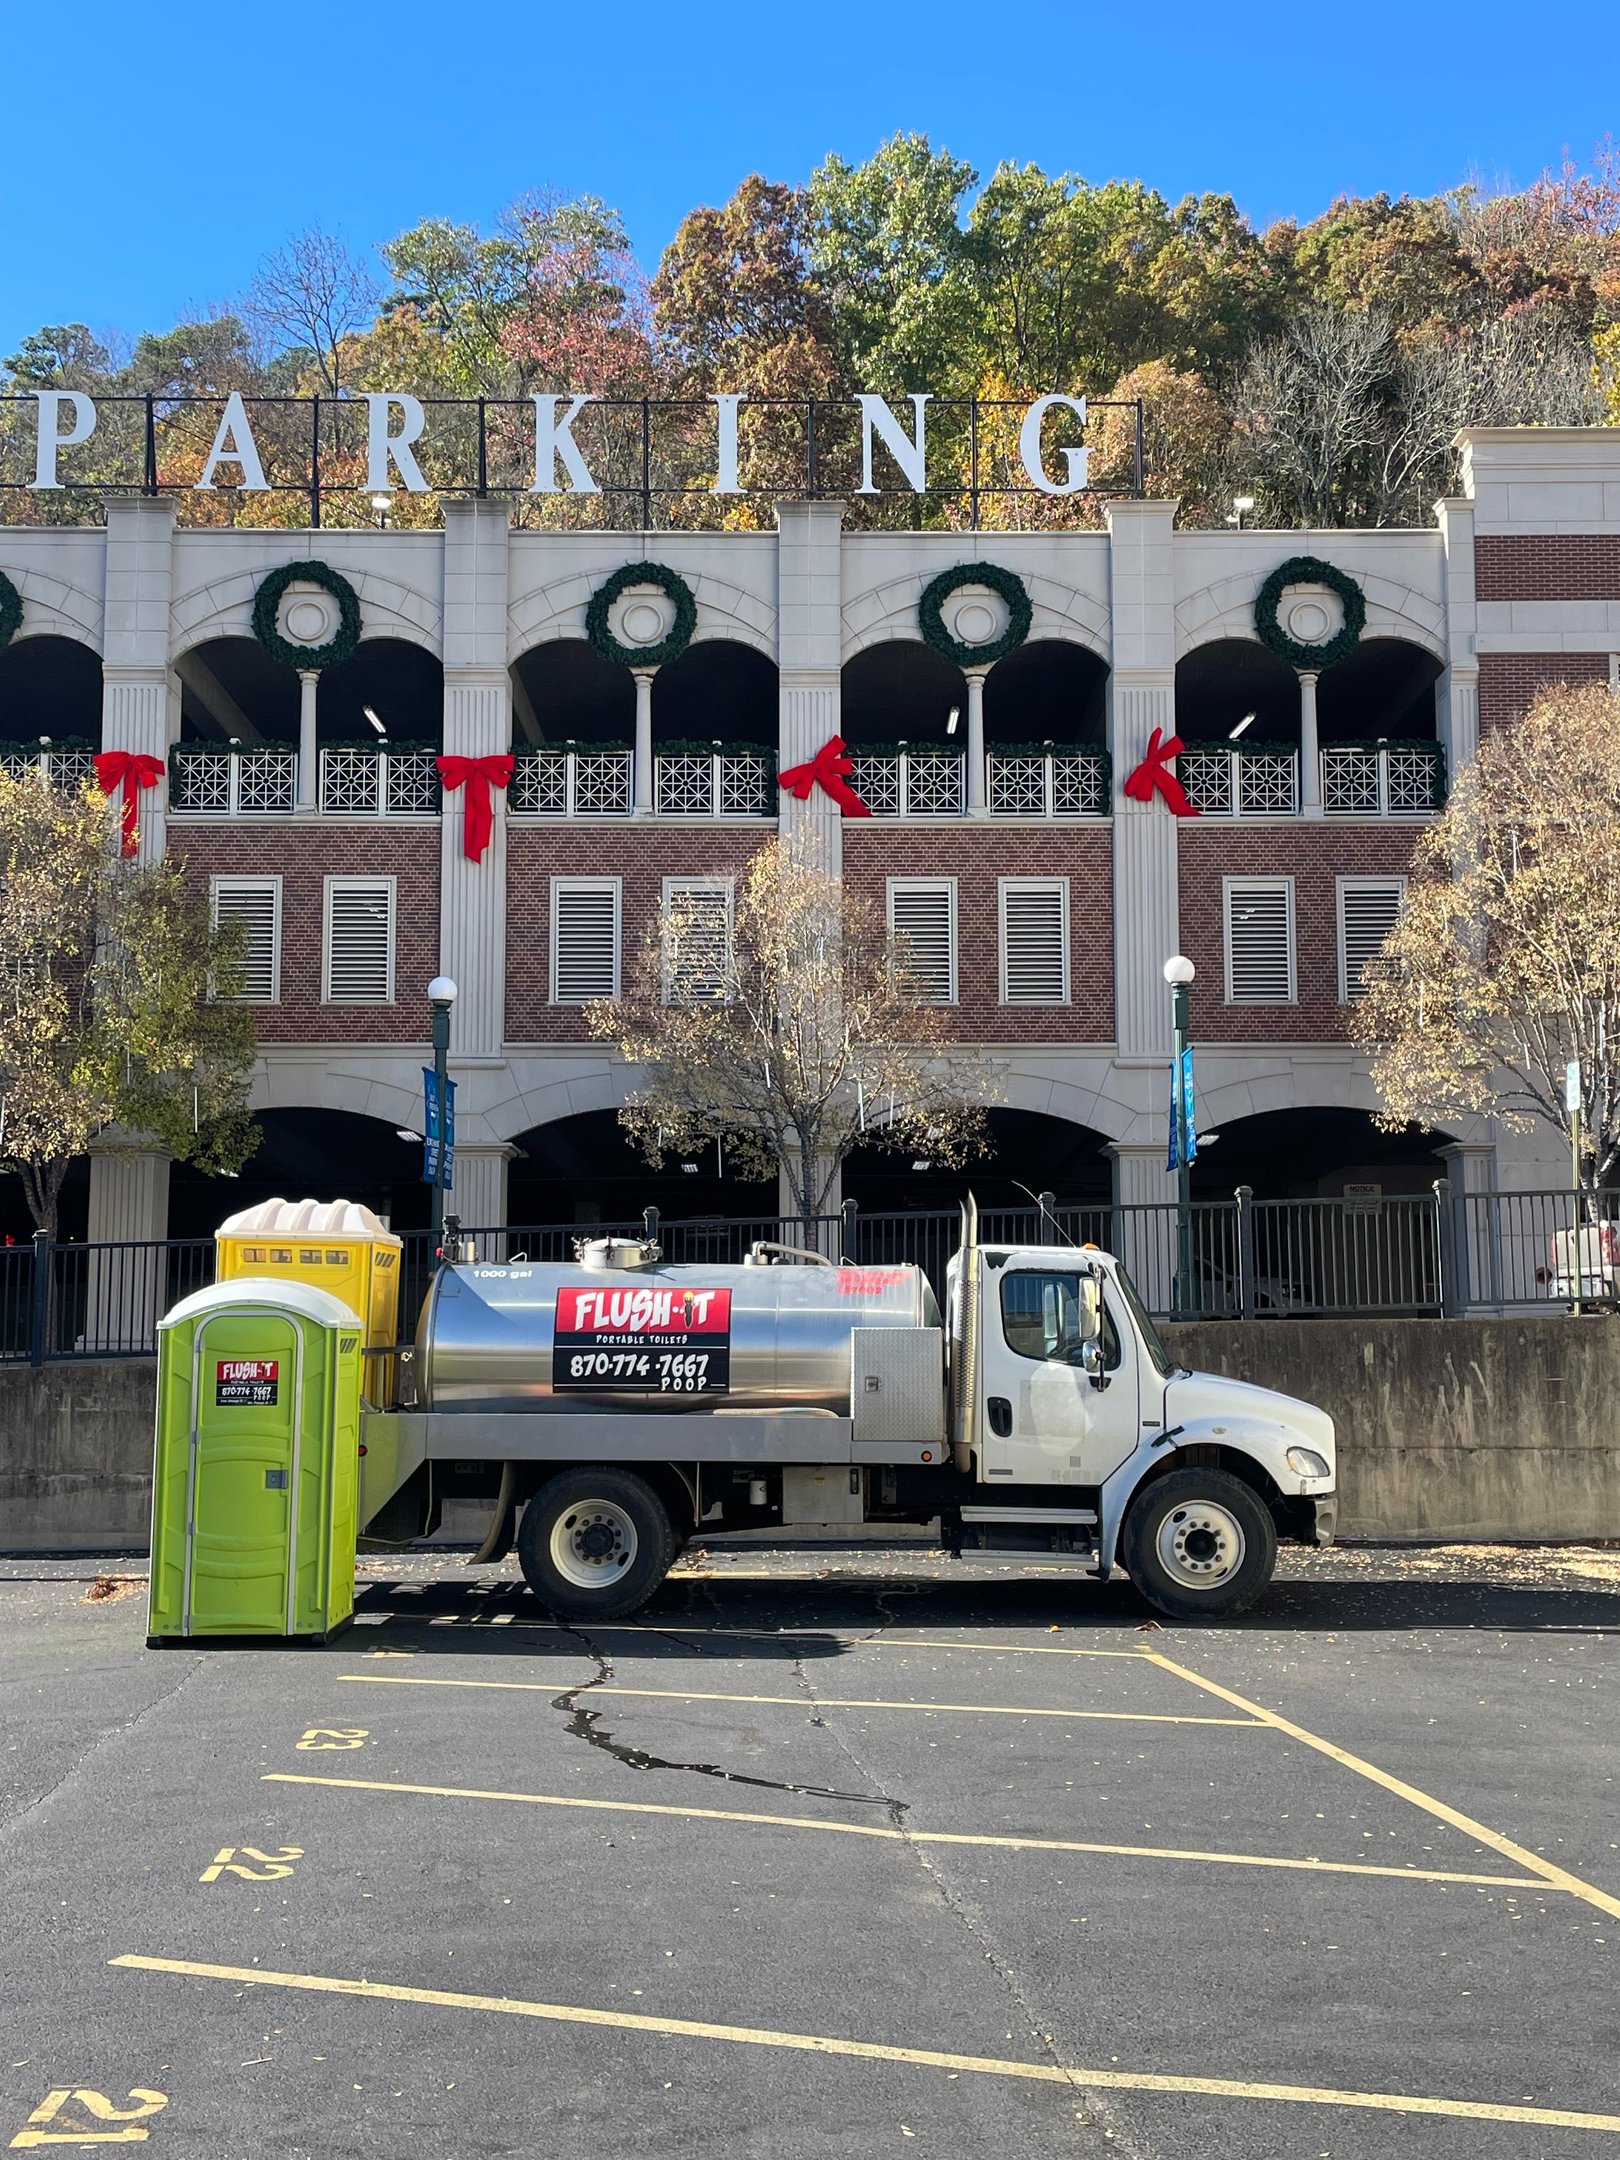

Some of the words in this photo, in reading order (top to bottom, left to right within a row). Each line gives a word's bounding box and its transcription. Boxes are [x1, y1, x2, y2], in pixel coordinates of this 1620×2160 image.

[25, 390, 1095, 494] PARKING
[473, 1270, 507, 1278] 1000
[509, 1270, 533, 1280] gal
[596, 1335, 645, 1344] PORTABLE
[649, 1335, 688, 1344] TOILETS
[661, 1376, 707, 1391] POOP
[295, 1729, 370, 1750] 23
[198, 1847, 305, 1882] 22
[8, 2088, 169, 2149] 21
